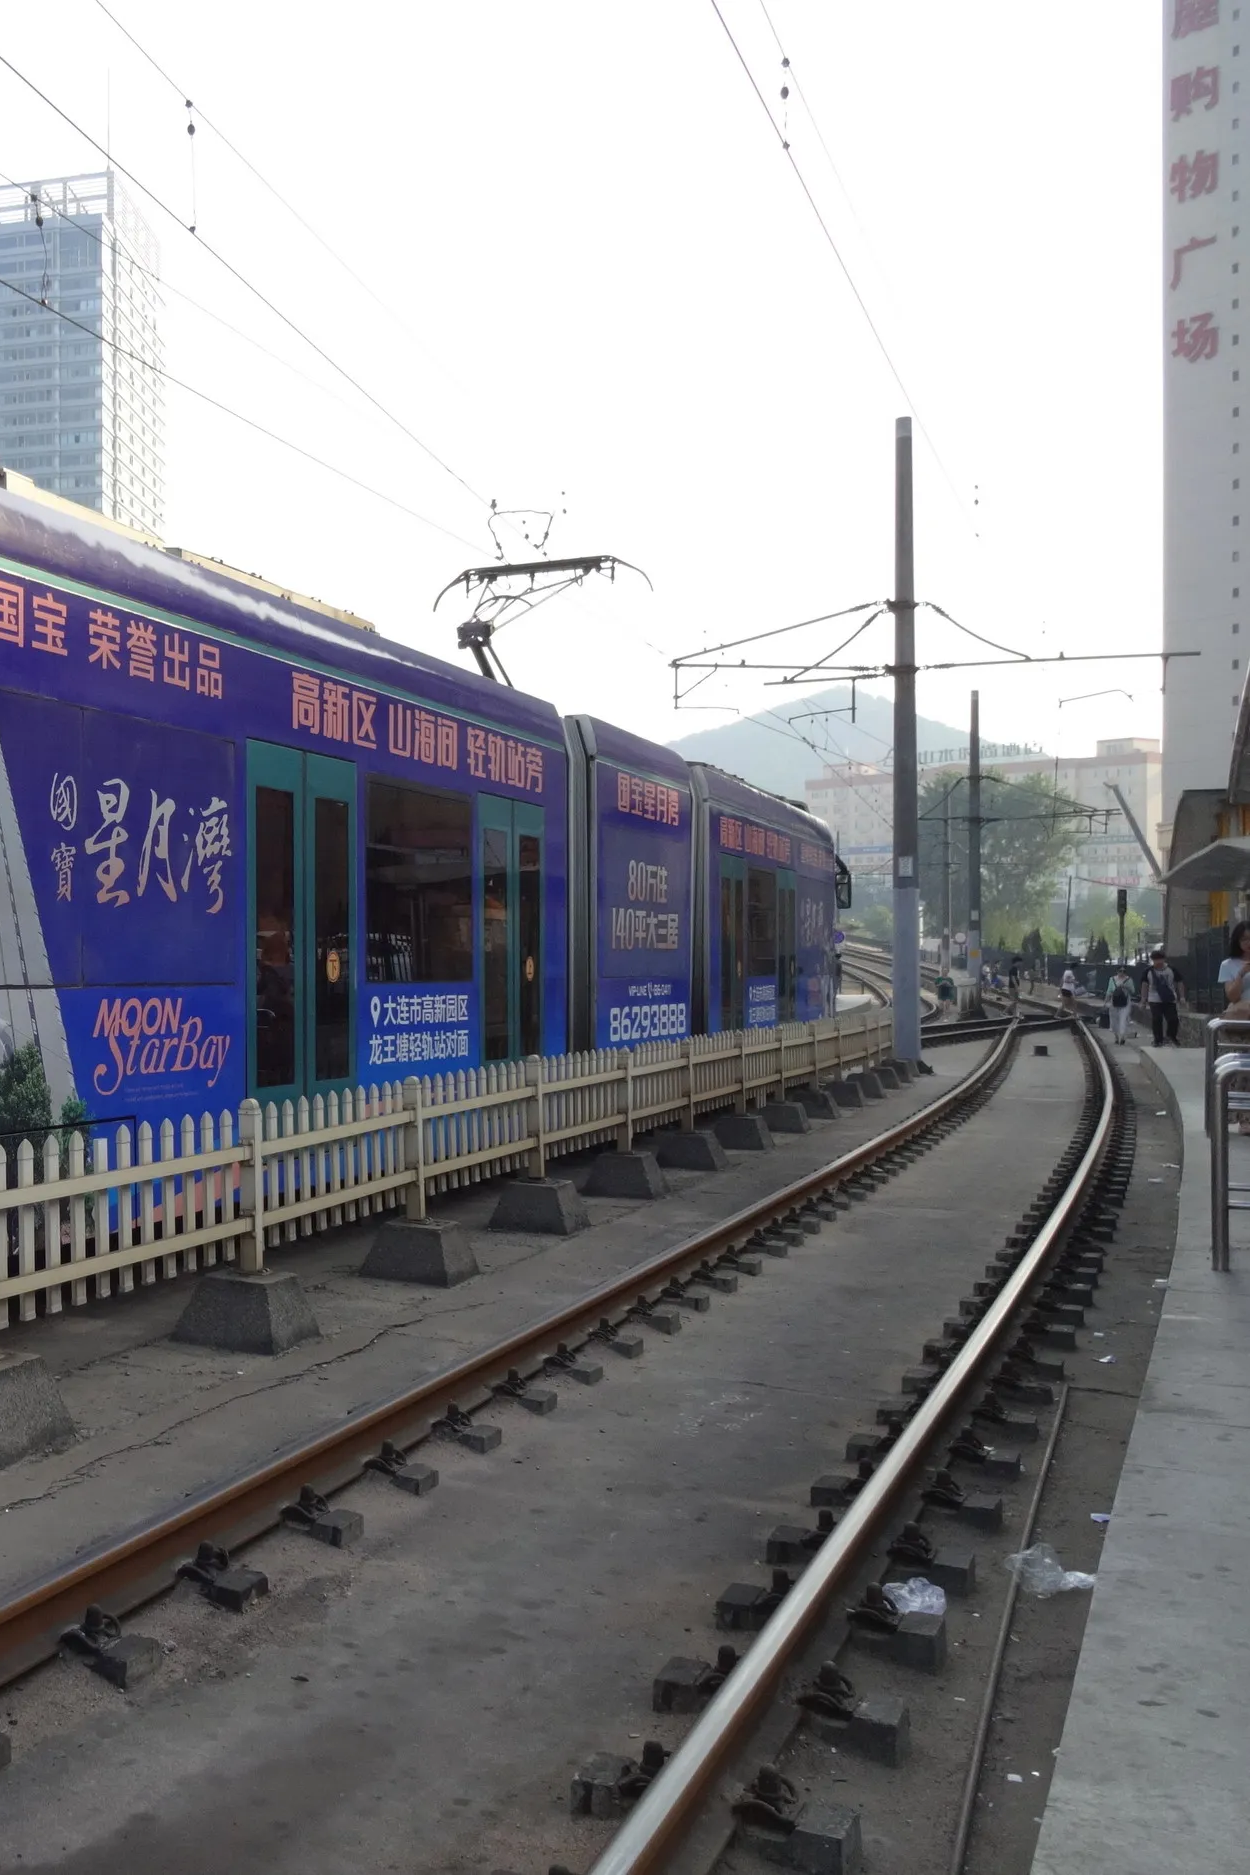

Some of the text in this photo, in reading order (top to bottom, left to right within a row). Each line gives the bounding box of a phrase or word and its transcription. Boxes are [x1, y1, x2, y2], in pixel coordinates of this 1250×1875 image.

[88, 608, 223, 699] 荣誉出品
[291, 671, 377, 750] 高新区
[388, 703, 458, 771] 山海间
[93, 997, 183, 1038] MOON
[383, 994, 469, 1026] 大连市高新园区
[610, 1003, 686, 1042] 86293888
[369, 1029, 469, 1066] 龙王塘轻轨站对面
